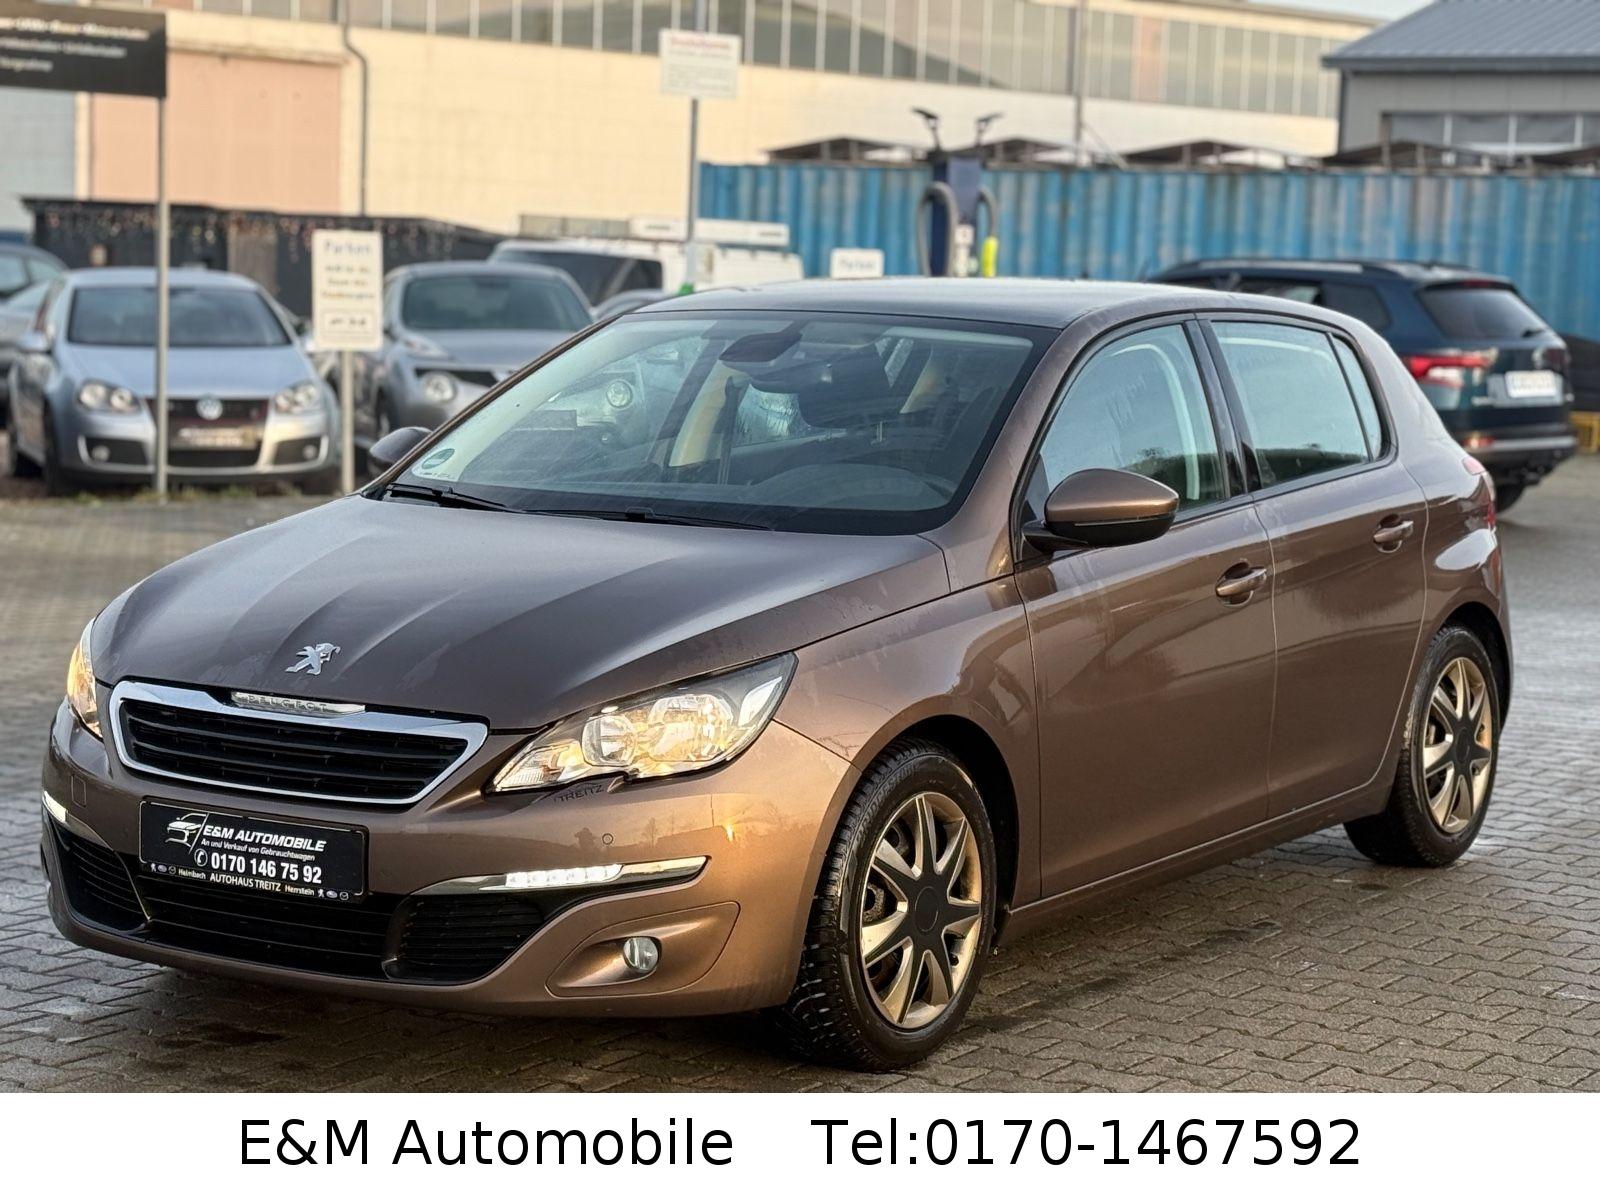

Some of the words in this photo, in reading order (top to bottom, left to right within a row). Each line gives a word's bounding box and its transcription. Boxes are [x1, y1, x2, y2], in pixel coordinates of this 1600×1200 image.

[247, 694, 327, 713] PEUGEOT
[201, 838, 210, 846] An
[211, 840, 223, 849] und
[223, 841, 247, 852] Verkauf
[248, 847, 260, 855] von
[260, 847, 316, 862] Gebrauchtwagen
[203, 825, 235, 840] E&M
[235, 830, 327, 852] AUTOMOBILE
[211, 852, 246, 874] 0170
[250, 858, 277, 878] 146
[280, 862, 299, 881] 75
[303, 865, 322, 884] 92
[209, 873, 254, 888] AUTOHAUS
[254, 879, 282, 892] TREITZ
